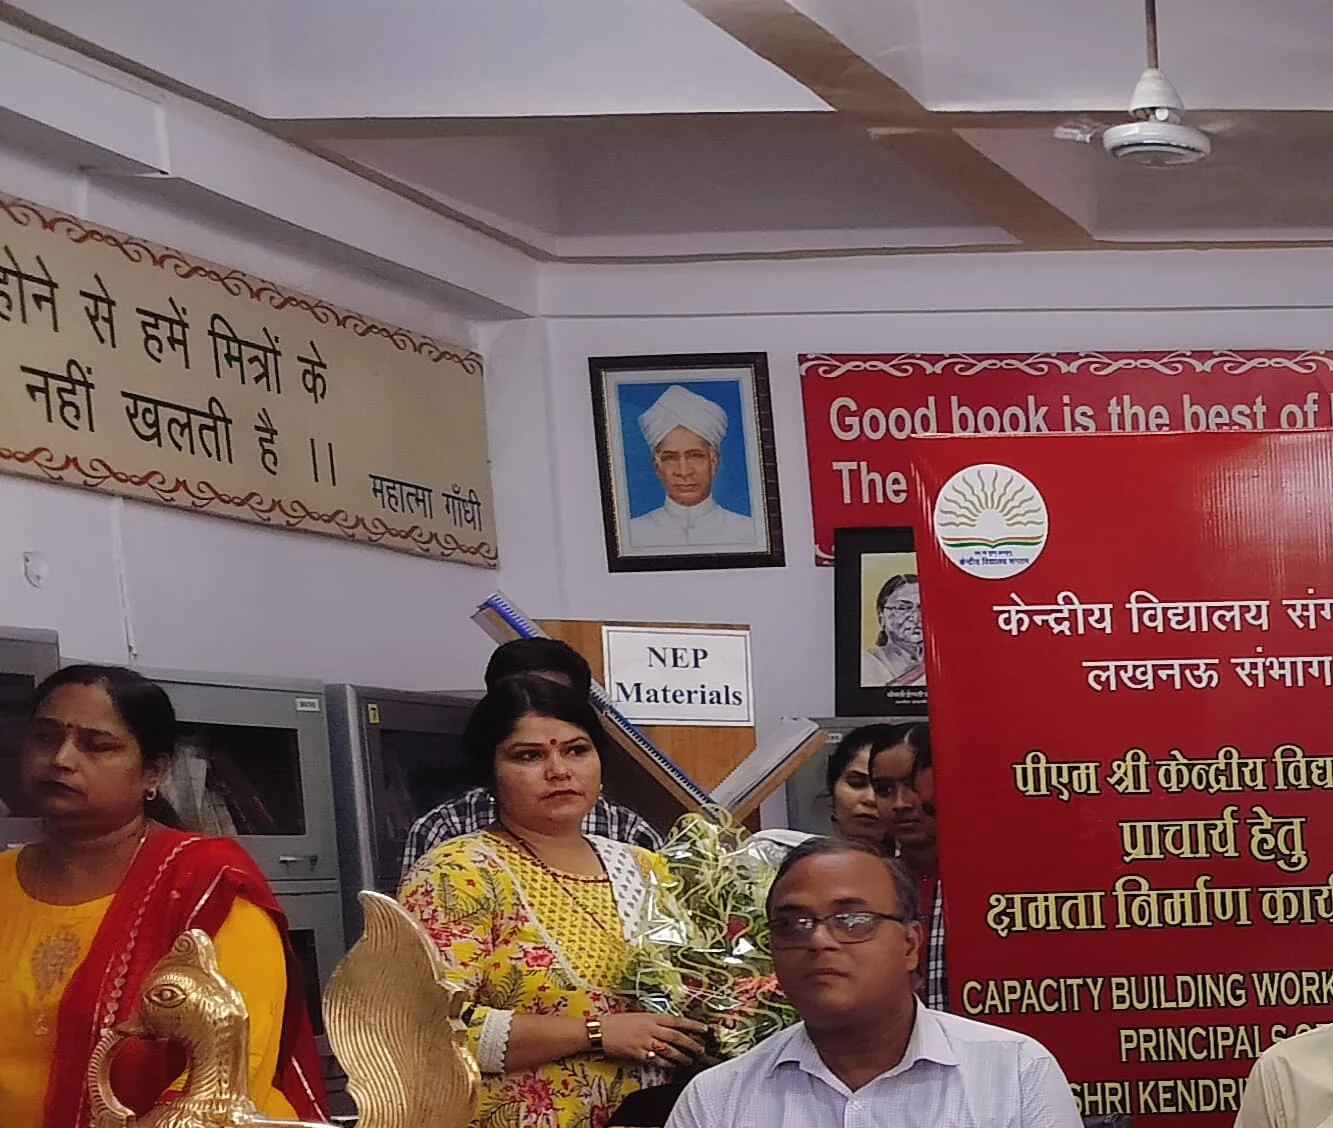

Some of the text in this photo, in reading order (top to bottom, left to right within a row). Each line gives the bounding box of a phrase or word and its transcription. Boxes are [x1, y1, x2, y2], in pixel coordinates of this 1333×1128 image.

[80, 273, 116, 349] से
[136, 297, 189, 369] हमें
[208, 313, 281, 394] मित्रों
[297, 340, 327, 404] के
[21, 359, 95, 432] नहीं
[121, 396, 232, 464] खलती
[254, 408, 278, 475] है
[830, 397, 938, 441] Good
[950, 395, 1049, 434] book
[1062, 394, 1095, 432] is
[1108, 394, 1170, 432] the
[1183, 394, 1266, 432] best
[1280, 392, 1320, 431] of
[369, 472, 432, 520] महात्मा
[833, 461, 908, 504] The
[992, 591, 1112, 636] केन्द्रीय
[1130, 591, 1270, 631] विद्यालय
[648, 646, 709, 669] NEP
[1082, 651, 1333, 692] लखनऊ संभाग
[616, 679, 744, 708] Materials
[1012, 749, 1099, 801] पीएम
[1106, 747, 1149, 794] श्री
[1155, 746, 1267, 795] केन्द्रीय
[1119, 805, 1308, 872] प्राचार्य हेतु
[986, 890, 1105, 938] क्षमता
[1113, 874, 1251, 929] निर्माण
[962, 976, 1103, 1015] CAPACITY
[1111, 974, 1246, 1011] BUILDING
